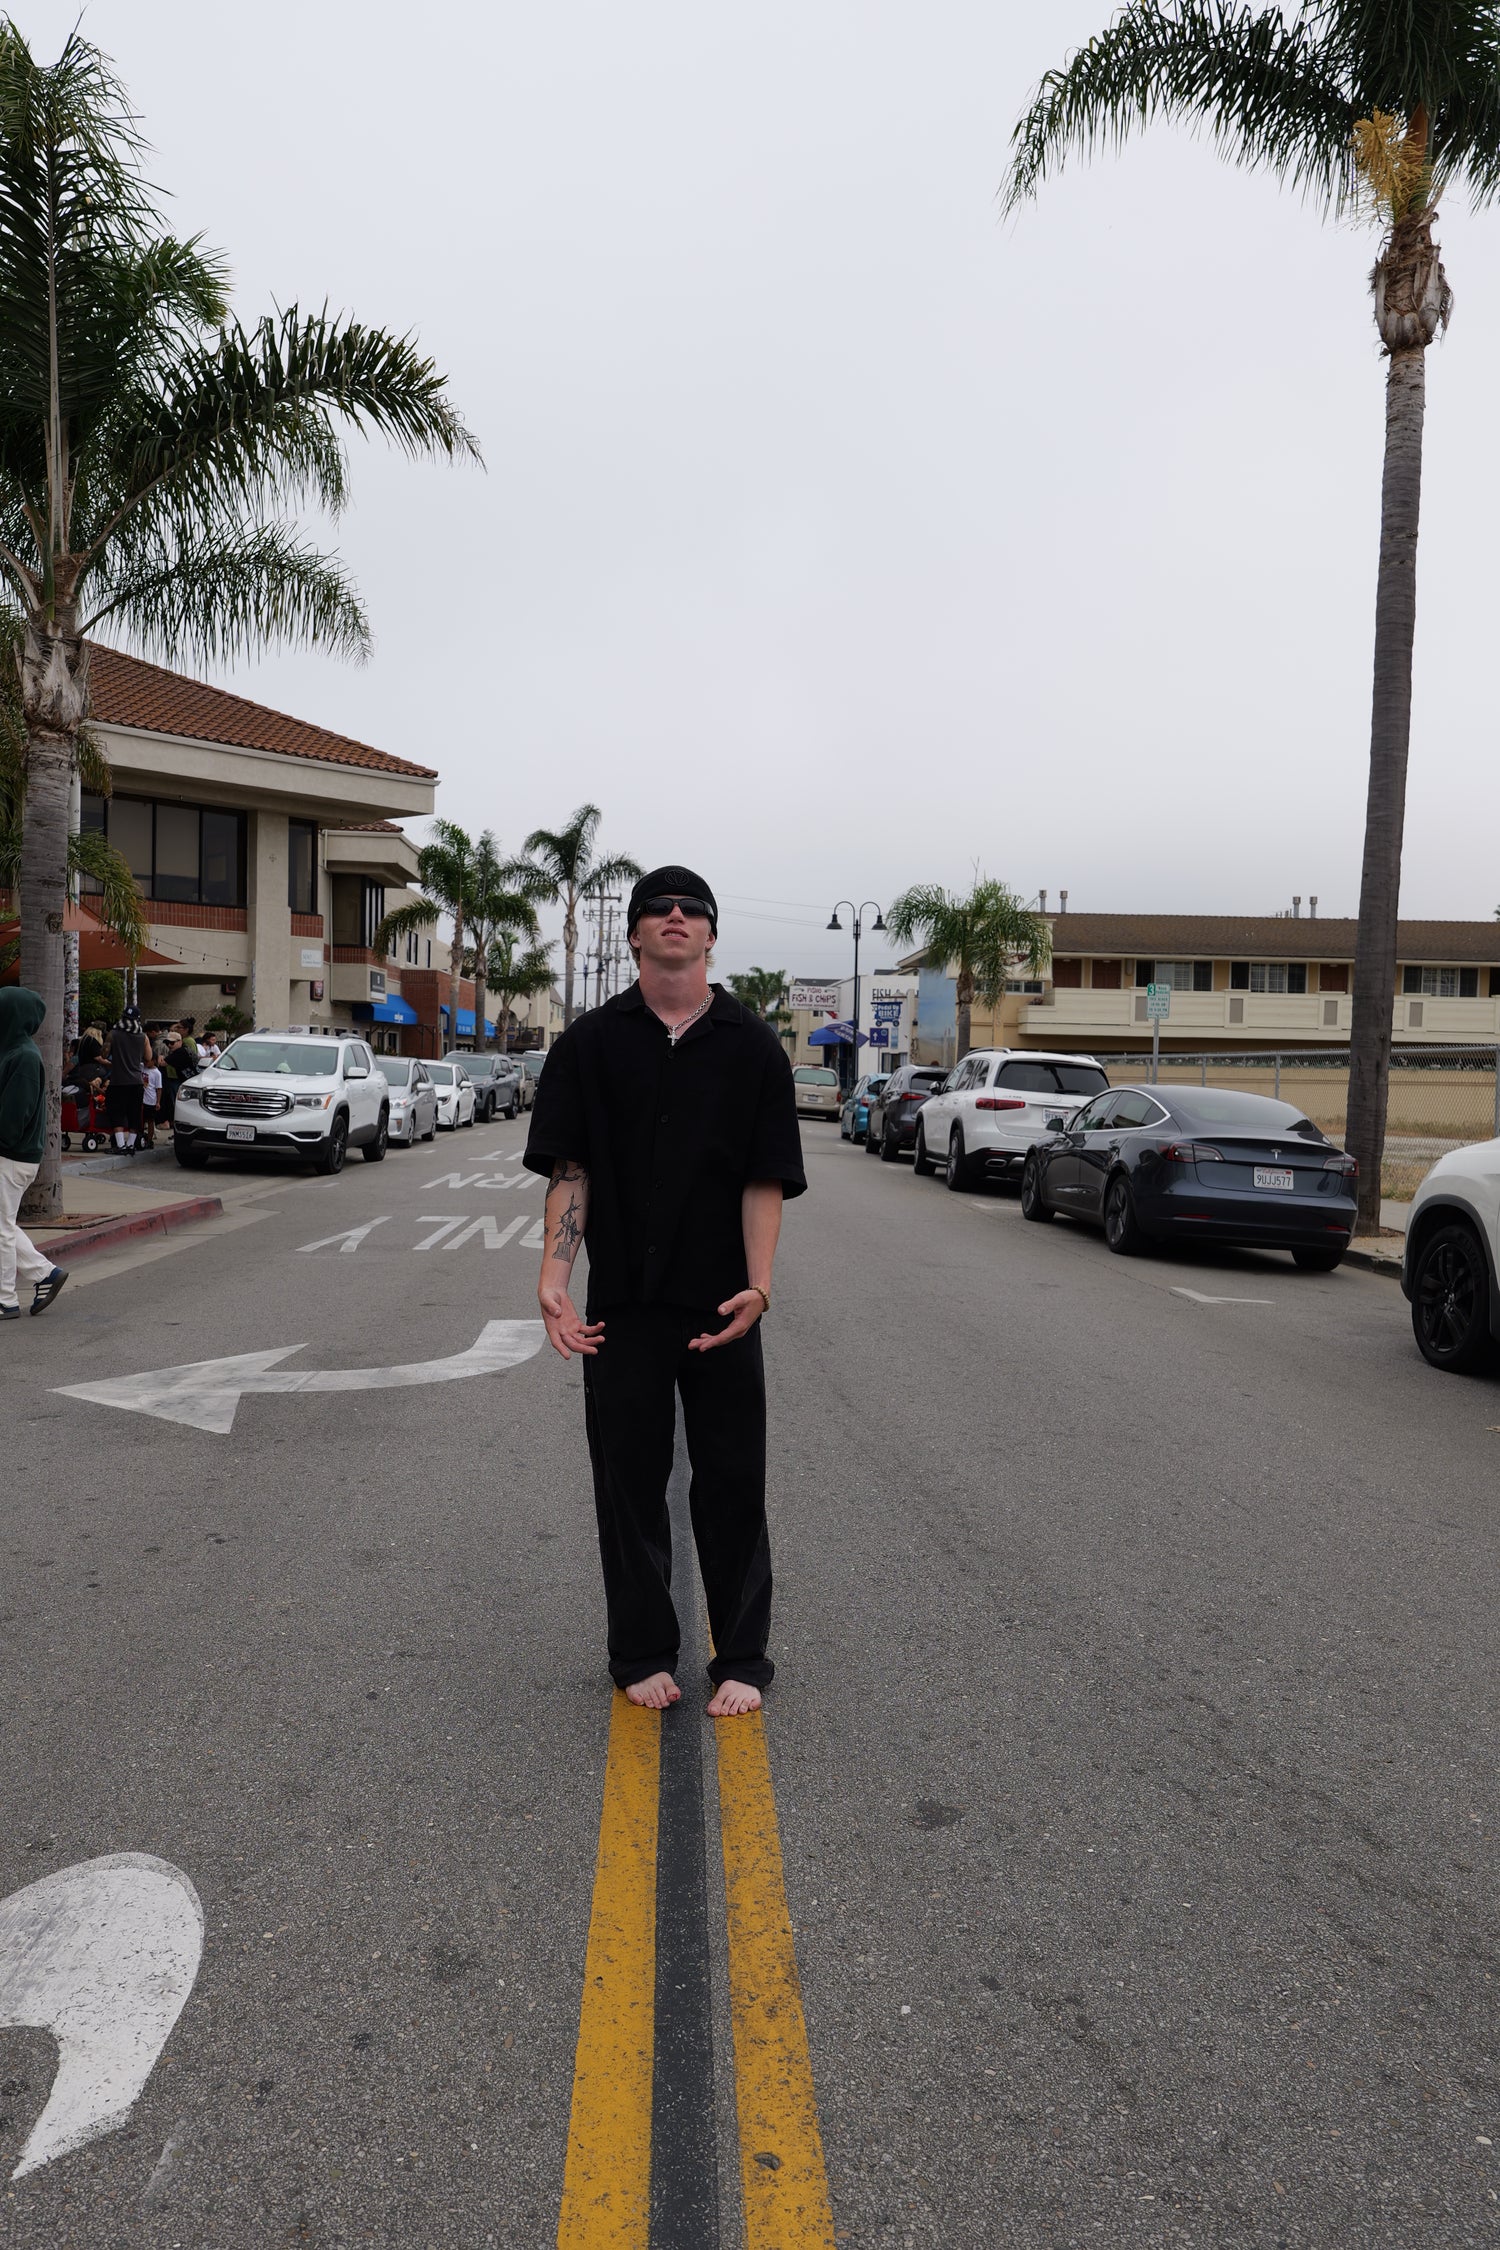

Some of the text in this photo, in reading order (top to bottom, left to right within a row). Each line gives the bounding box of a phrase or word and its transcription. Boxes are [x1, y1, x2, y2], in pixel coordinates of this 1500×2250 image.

[1149, 984, 1155, 995] 3
[791, 994, 807, 1002] FISH
[815, 995, 837, 1004] CHIPS
[1257, 1174, 1291, 1186] 9UJJ577
